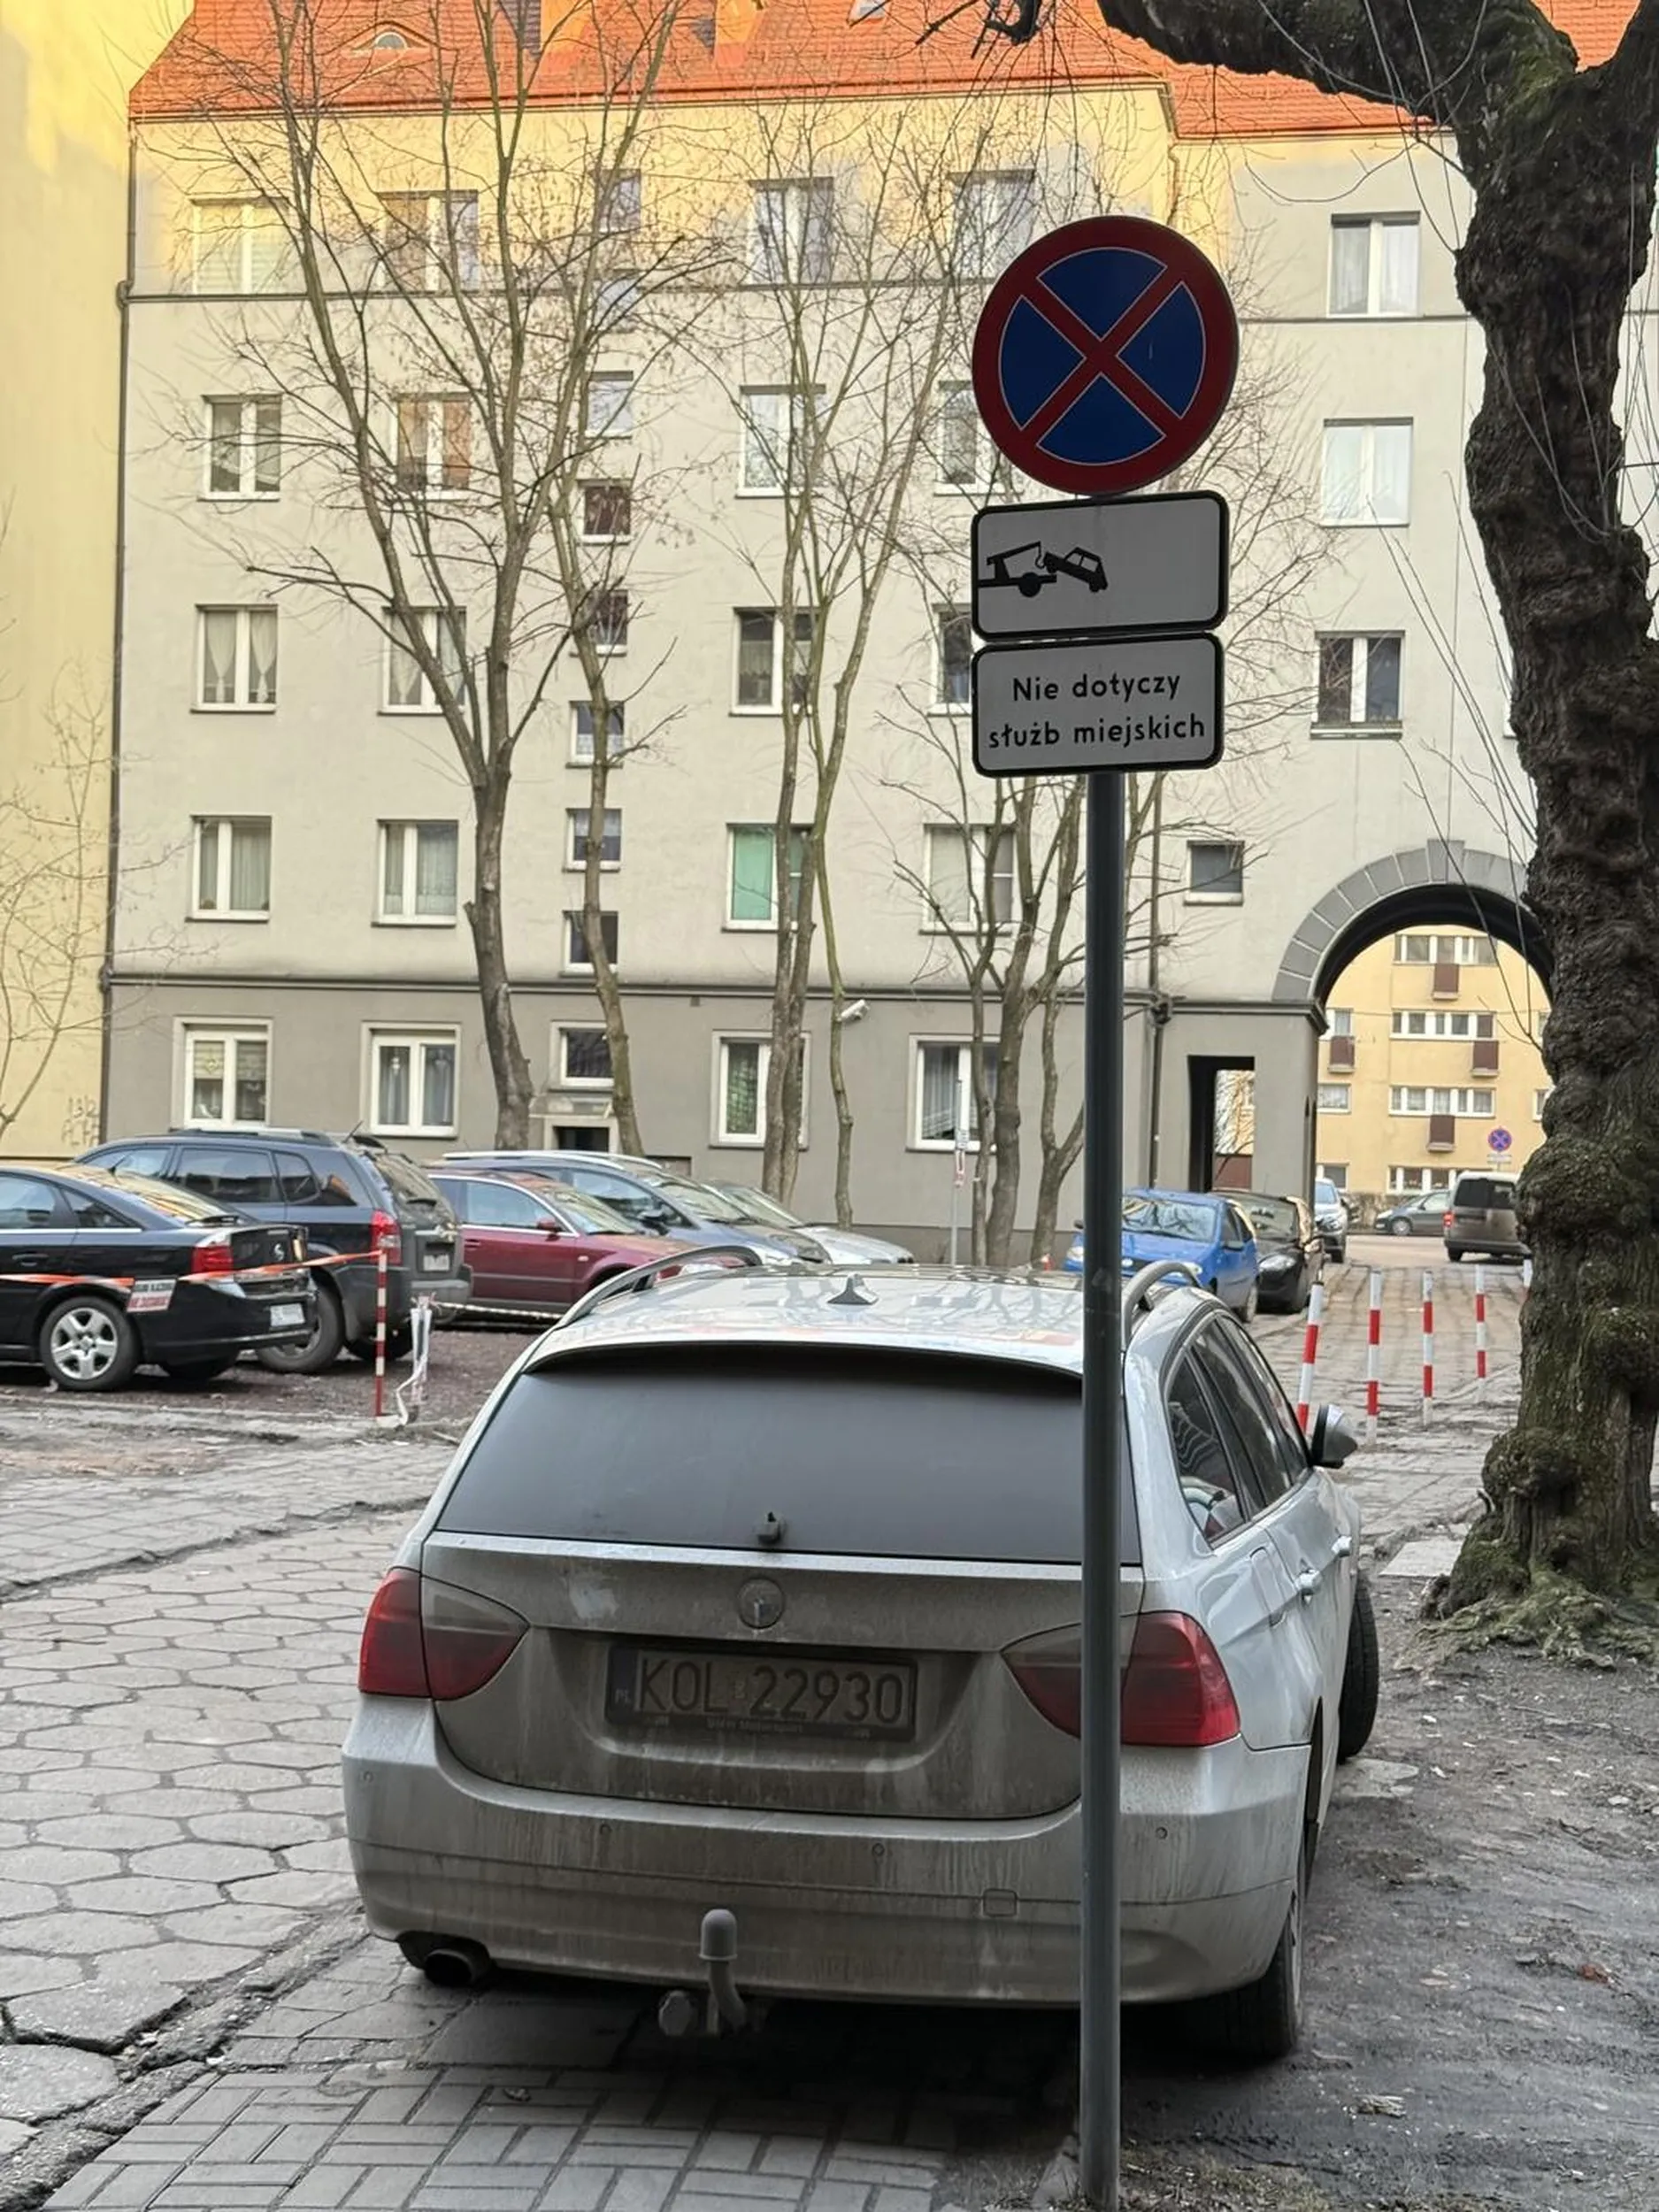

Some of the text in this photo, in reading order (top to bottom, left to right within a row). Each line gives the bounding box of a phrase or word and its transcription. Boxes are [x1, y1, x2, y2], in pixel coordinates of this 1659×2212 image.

[1013, 673, 1180, 703] Nie dotyczy
[988, 713, 1205, 749] służb miejskich
[640, 1659, 902, 1724] KOL 22930
